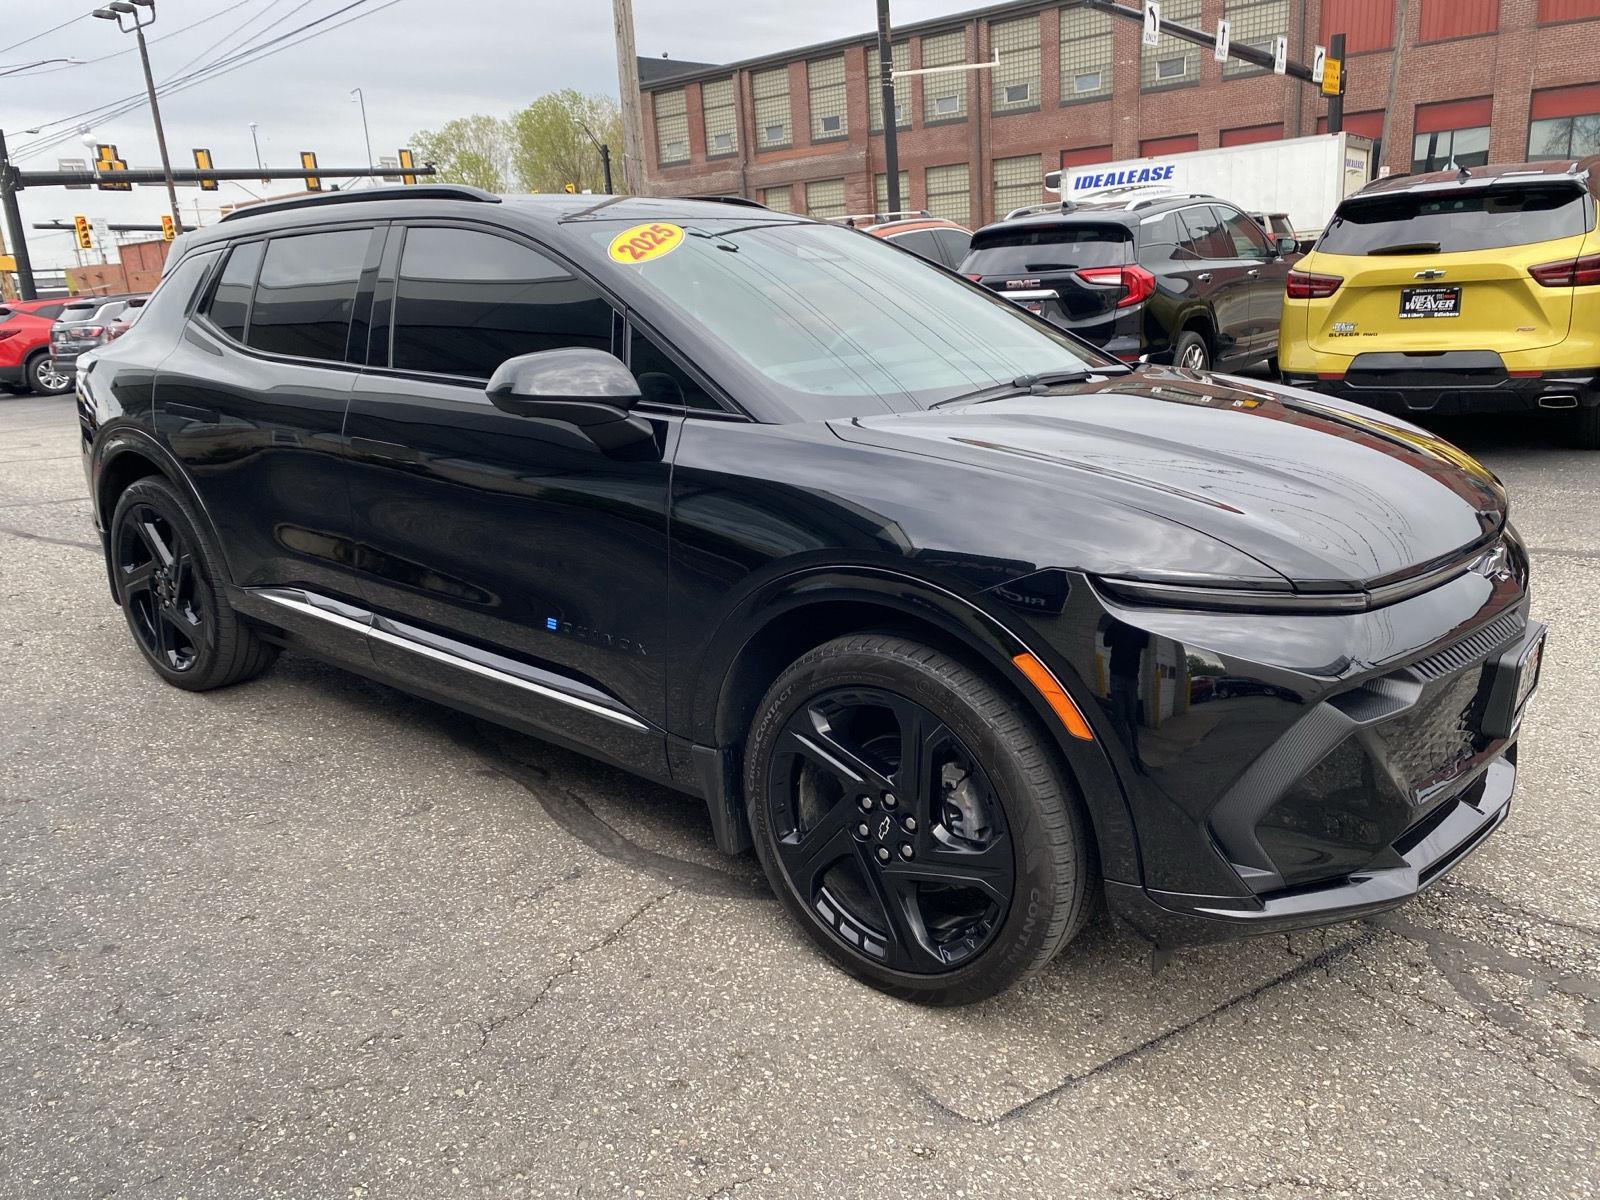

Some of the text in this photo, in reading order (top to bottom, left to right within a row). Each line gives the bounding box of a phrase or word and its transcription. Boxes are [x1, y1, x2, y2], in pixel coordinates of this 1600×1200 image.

[1145, 32, 1157, 43] ONLY
[1074, 165, 1175, 190] IDEALEASE
[618, 225, 674, 260] 2025
[1006, 279, 1041, 289] GMC
[1405, 300, 1455, 310] WEAVER
